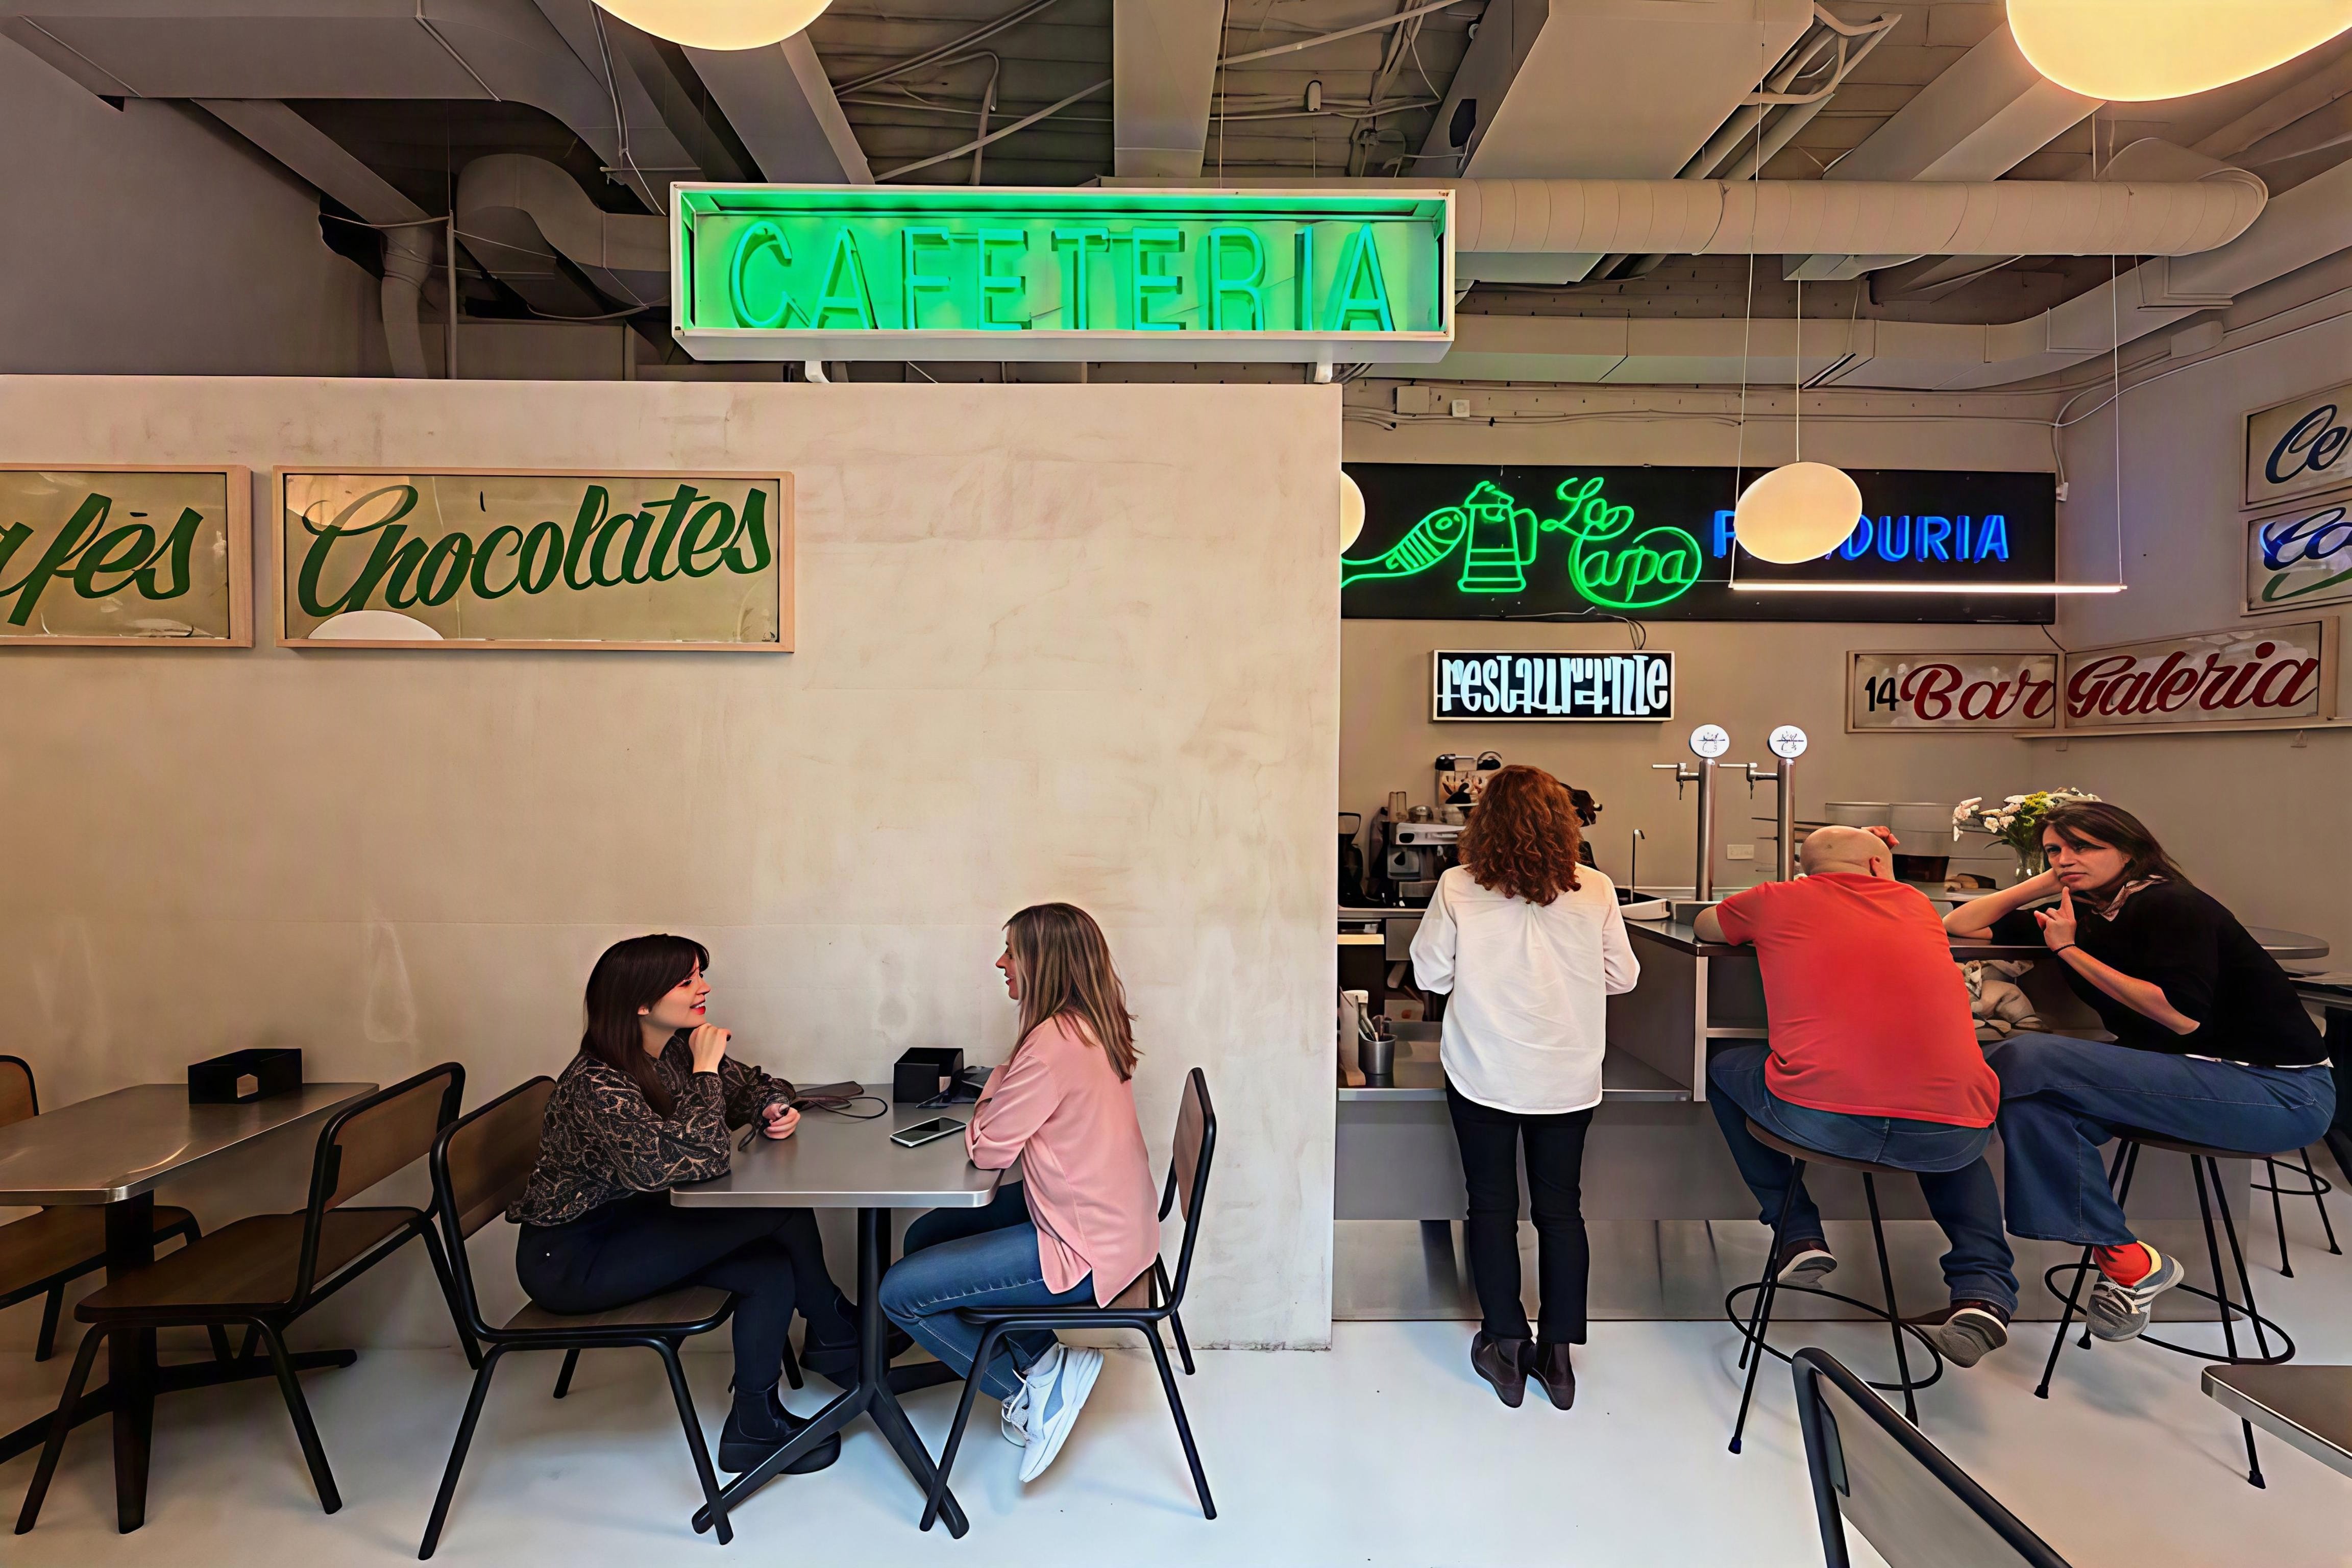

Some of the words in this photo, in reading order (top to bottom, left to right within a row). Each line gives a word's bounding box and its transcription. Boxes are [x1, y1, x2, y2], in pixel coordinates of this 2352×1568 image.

[730, 221, 1394, 331] CAFETERIA
[1540, 477, 1634, 540] La
[1713, 510, 2010, 562] FDURIA
[298, 483, 772, 617] Chocolates
[1568, 526, 1702, 608] Carpa
[1442, 655, 1668, 715] restaurante
[1865, 676, 1900, 713] 14
[1899, 663, 2055, 721] Bar
[2067, 642, 2319, 719] Galeria
